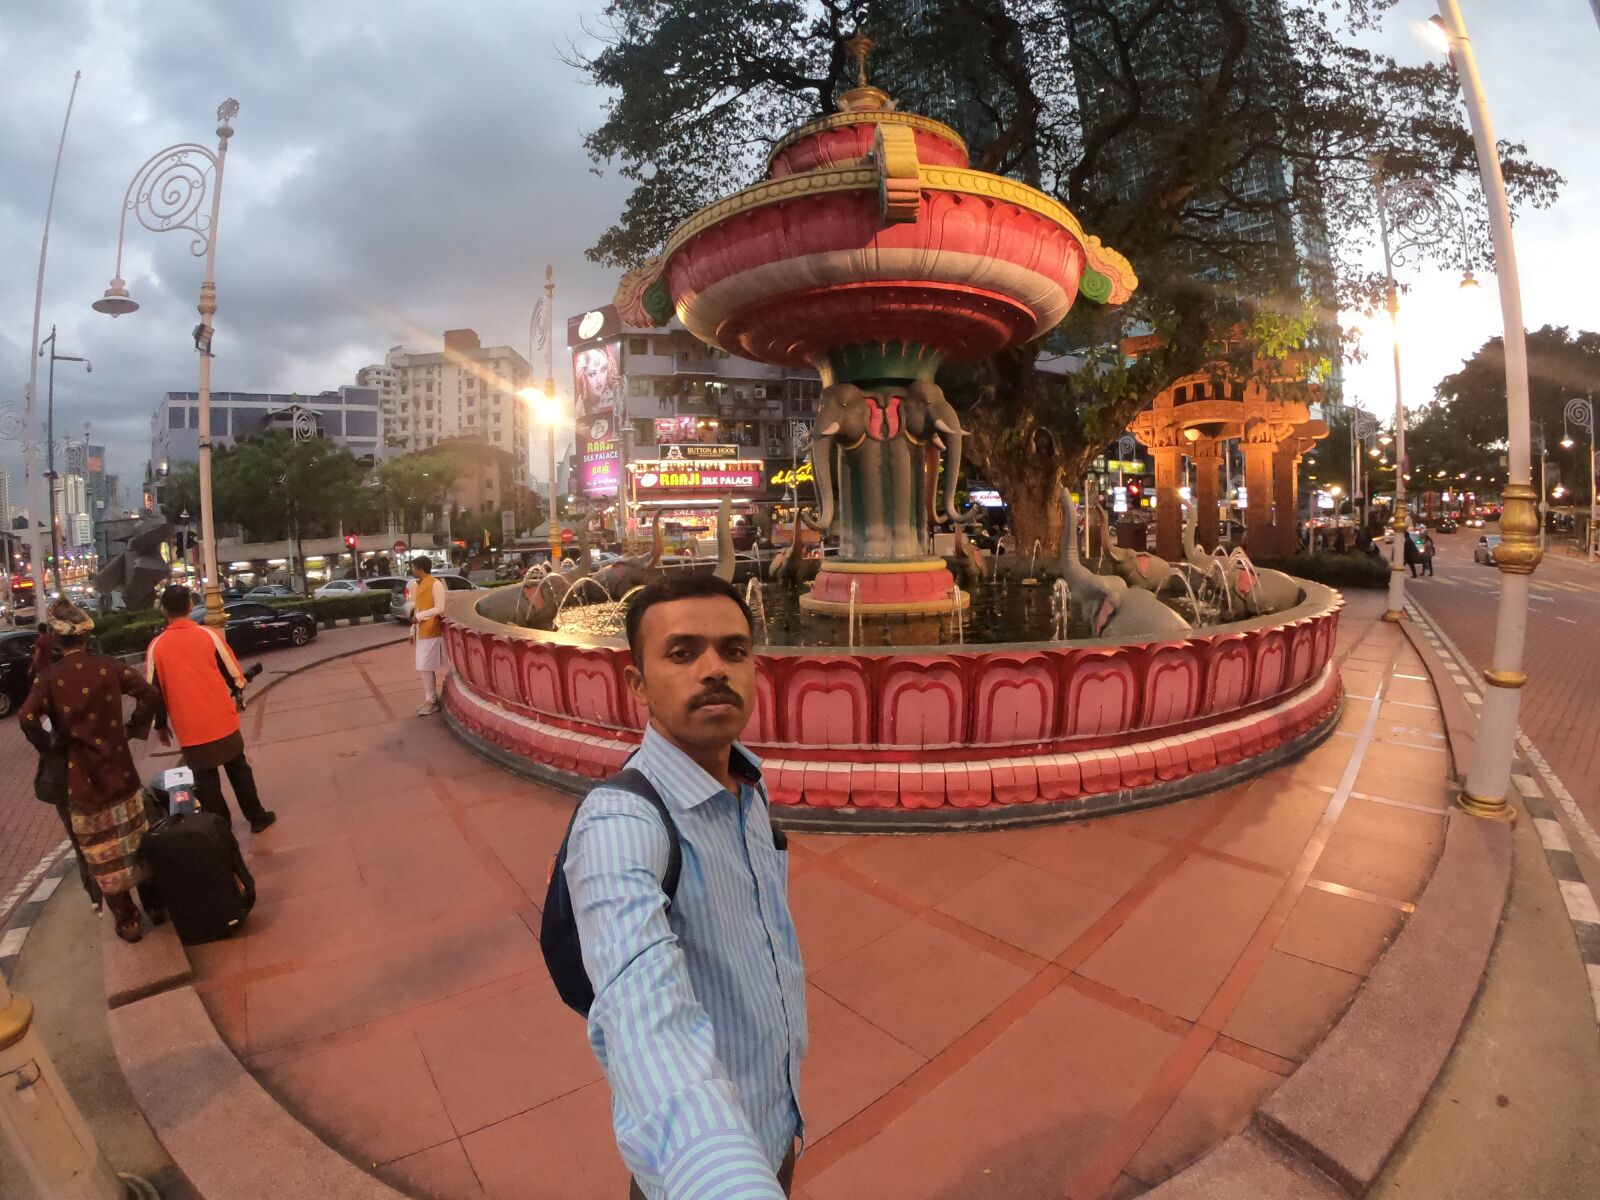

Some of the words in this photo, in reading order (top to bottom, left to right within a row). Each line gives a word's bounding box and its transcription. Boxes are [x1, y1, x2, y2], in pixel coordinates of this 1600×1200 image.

[583, 454, 594, 463] SILK
[595, 451, 619, 461] PALACE
[687, 447, 711, 455] BUTTON
[660, 473, 700, 486] RAAJI
[701, 476, 719, 485] SILK
[720, 476, 753, 485] PALACE
